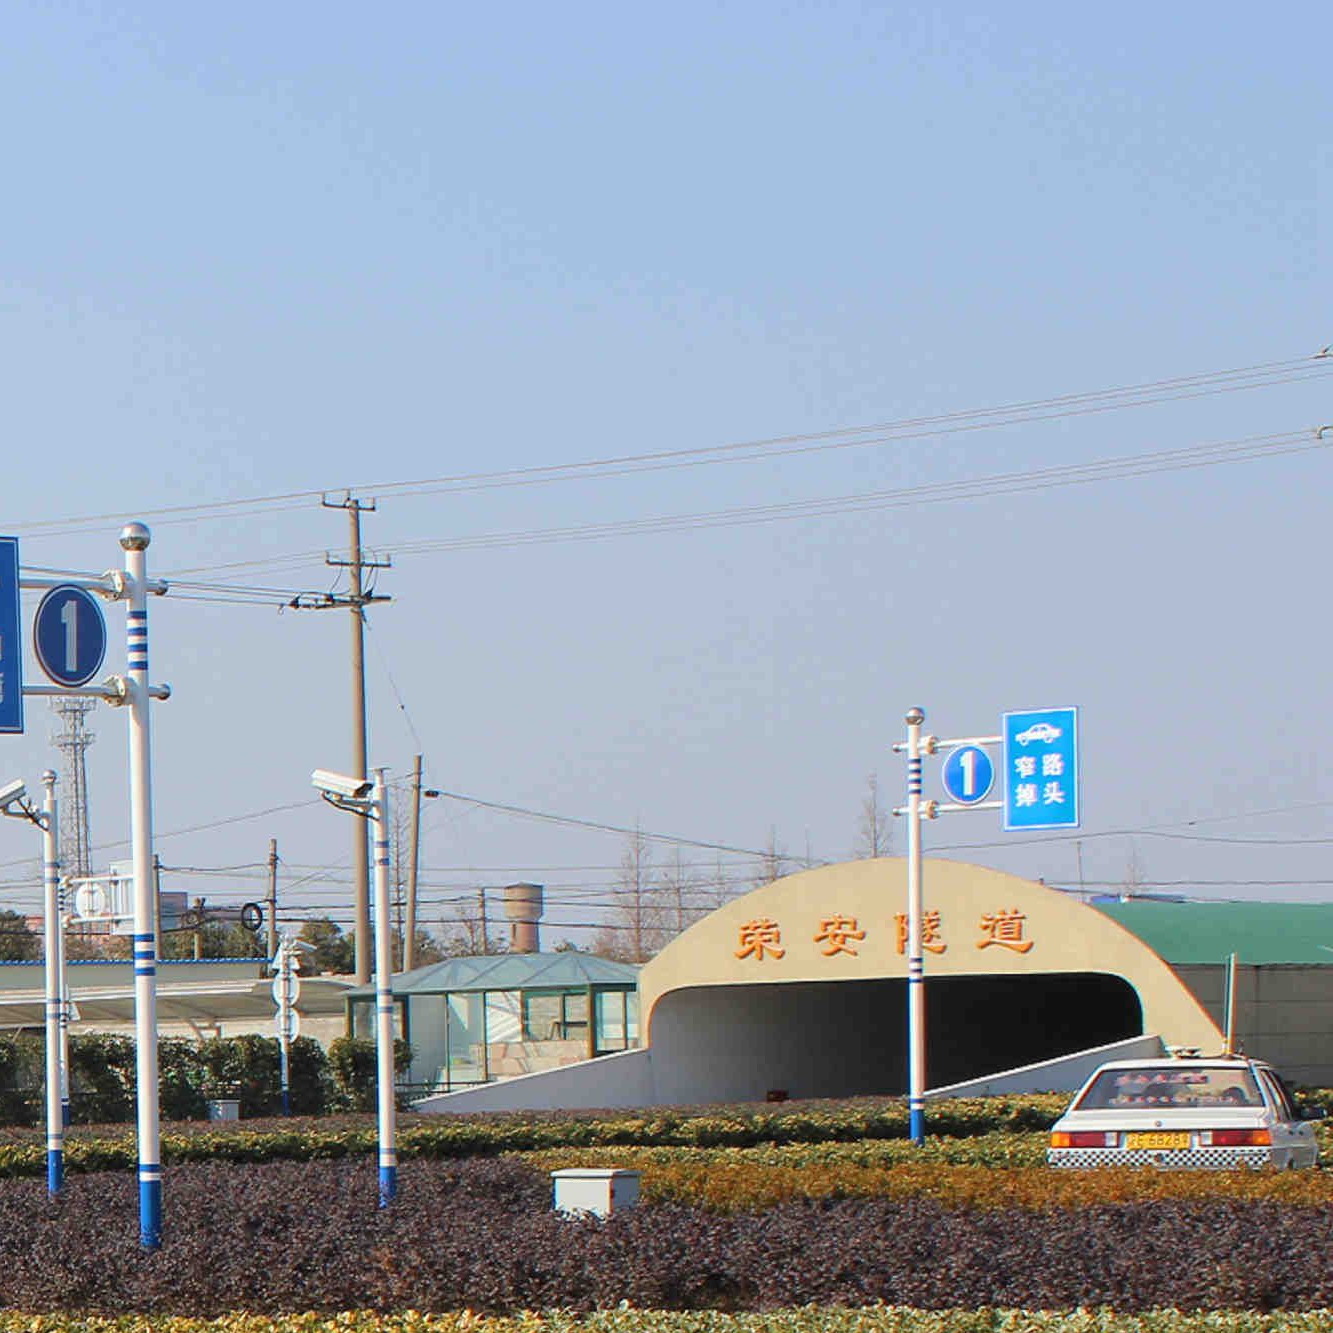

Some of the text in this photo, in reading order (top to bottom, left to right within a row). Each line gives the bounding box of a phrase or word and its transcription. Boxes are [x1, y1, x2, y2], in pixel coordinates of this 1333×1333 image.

[60, 600, 77, 672] 1
[960, 751, 974, 795] 1
[1014, 753, 1064, 778] 窄路
[1015, 782, 1064, 807] 掉头
[734, 909, 1034, 961] 荣安隧道
